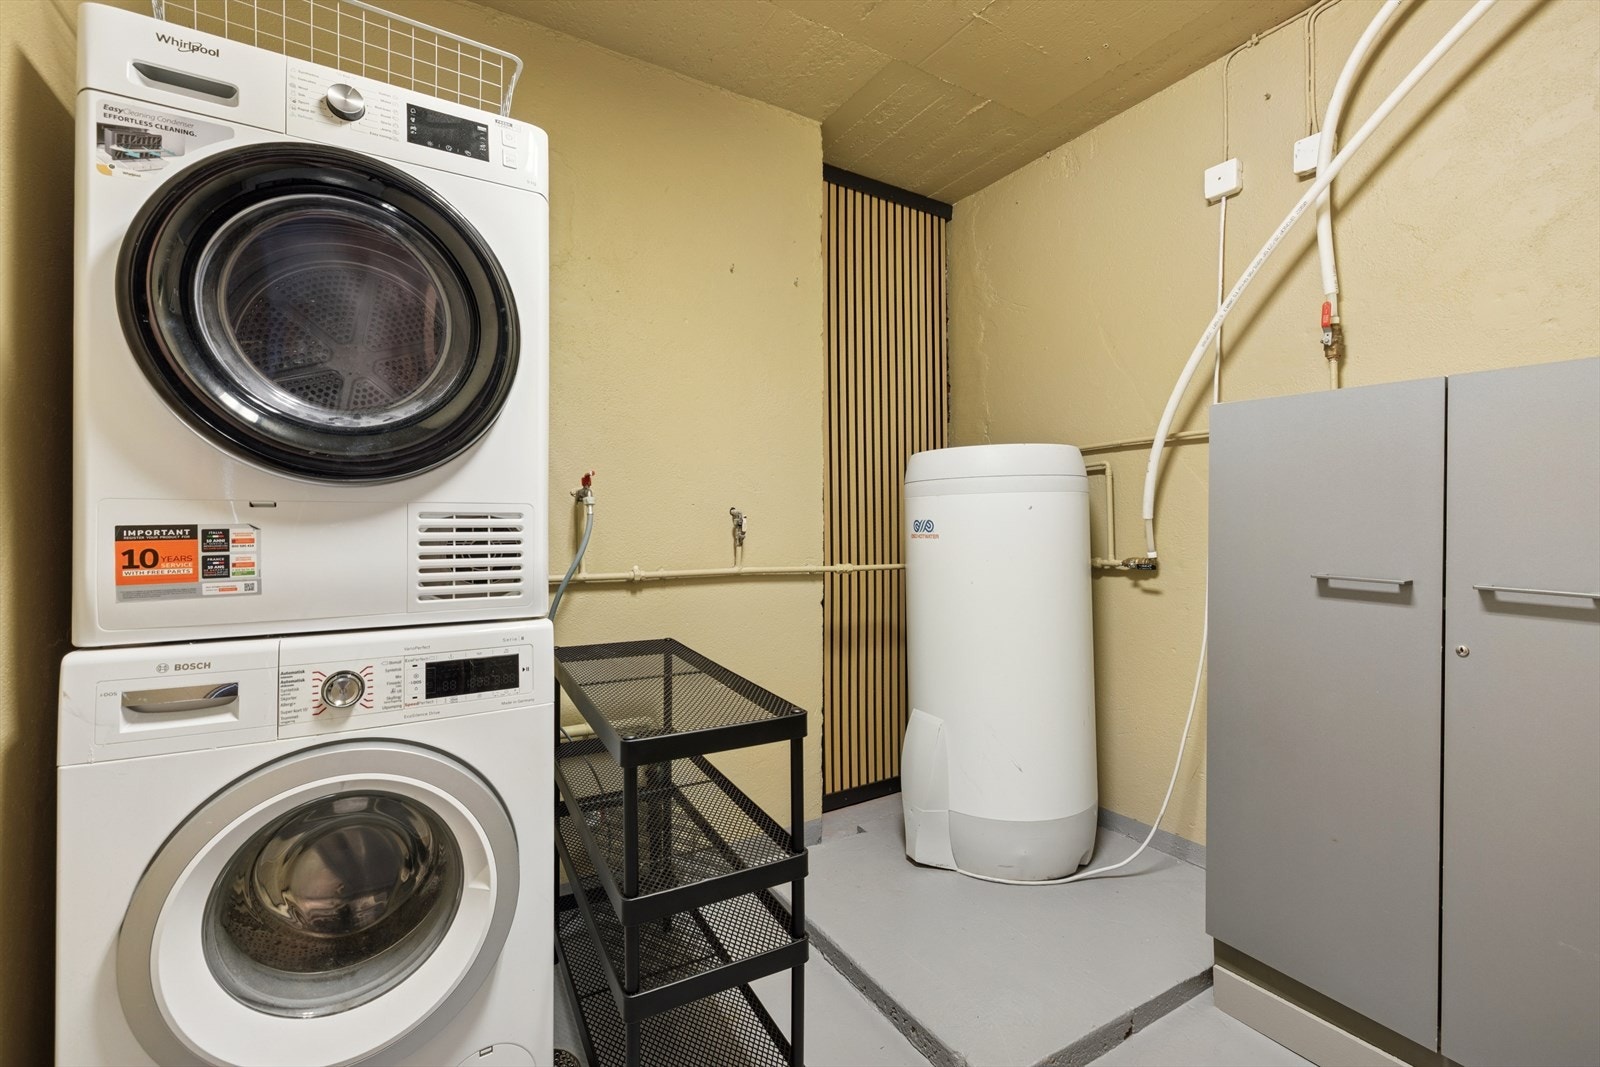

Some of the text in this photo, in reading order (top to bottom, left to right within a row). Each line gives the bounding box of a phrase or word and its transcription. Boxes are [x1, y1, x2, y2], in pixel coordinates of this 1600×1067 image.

[156, 31, 220, 58] Whirlpool
[103, 112, 198, 138] EFFORTLESS CLEANING.
[156, 115, 194, 129] Condenser
[121, 548, 159, 569] 10
[174, 662, 211, 672] BOSCH
